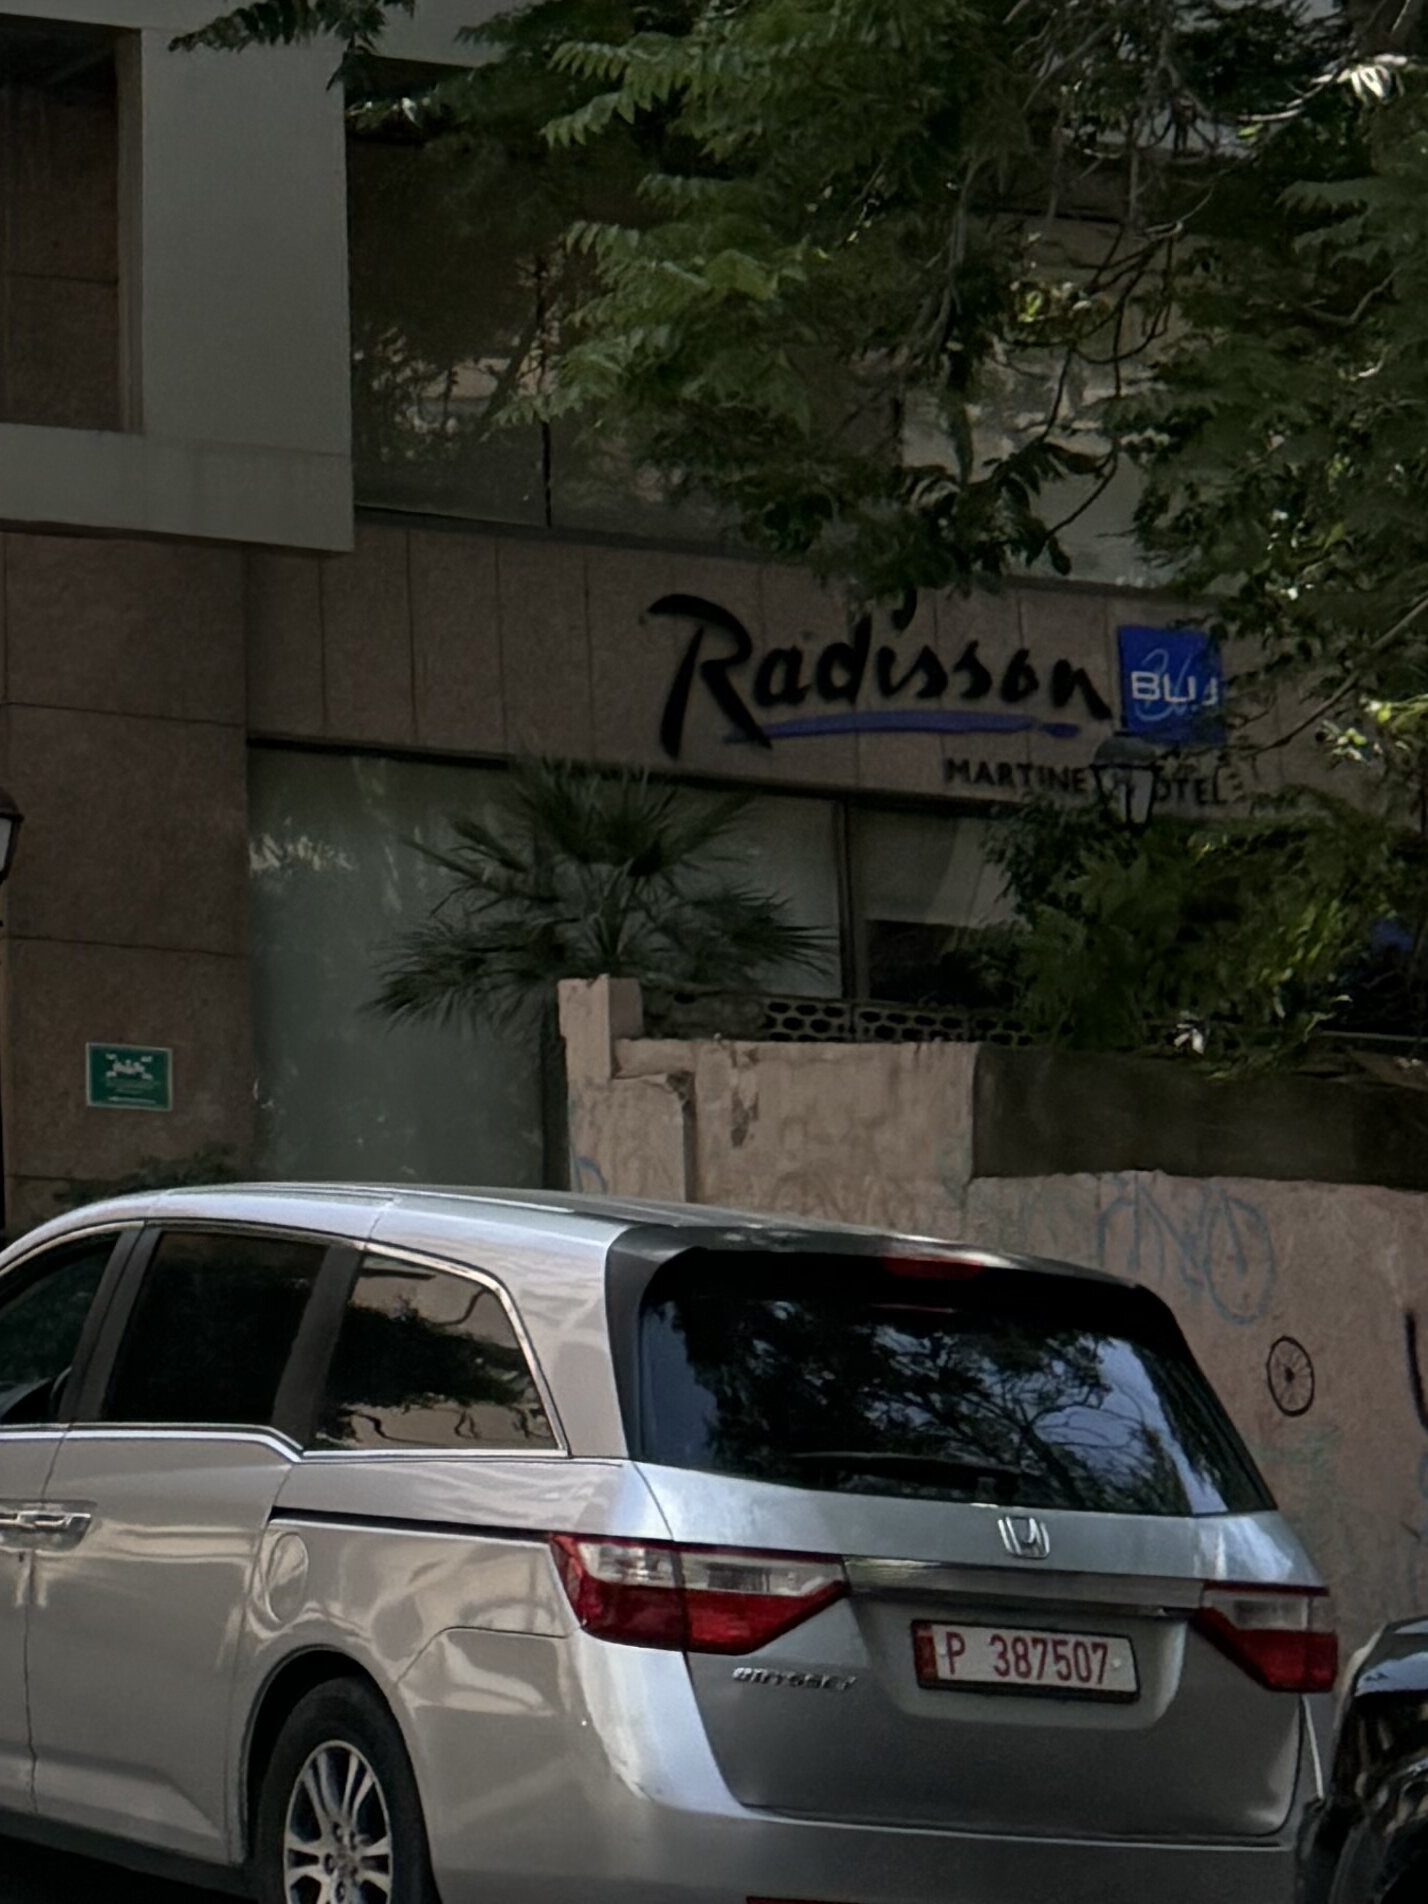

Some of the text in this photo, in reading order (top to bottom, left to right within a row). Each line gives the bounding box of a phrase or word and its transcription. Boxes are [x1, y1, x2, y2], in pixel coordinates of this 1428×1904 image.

[647, 590, 1219, 762] Radisson BLU
[944, 756, 1228, 804] MARTINE OTEL
[945, 1631, 1108, 1685] P 387507
